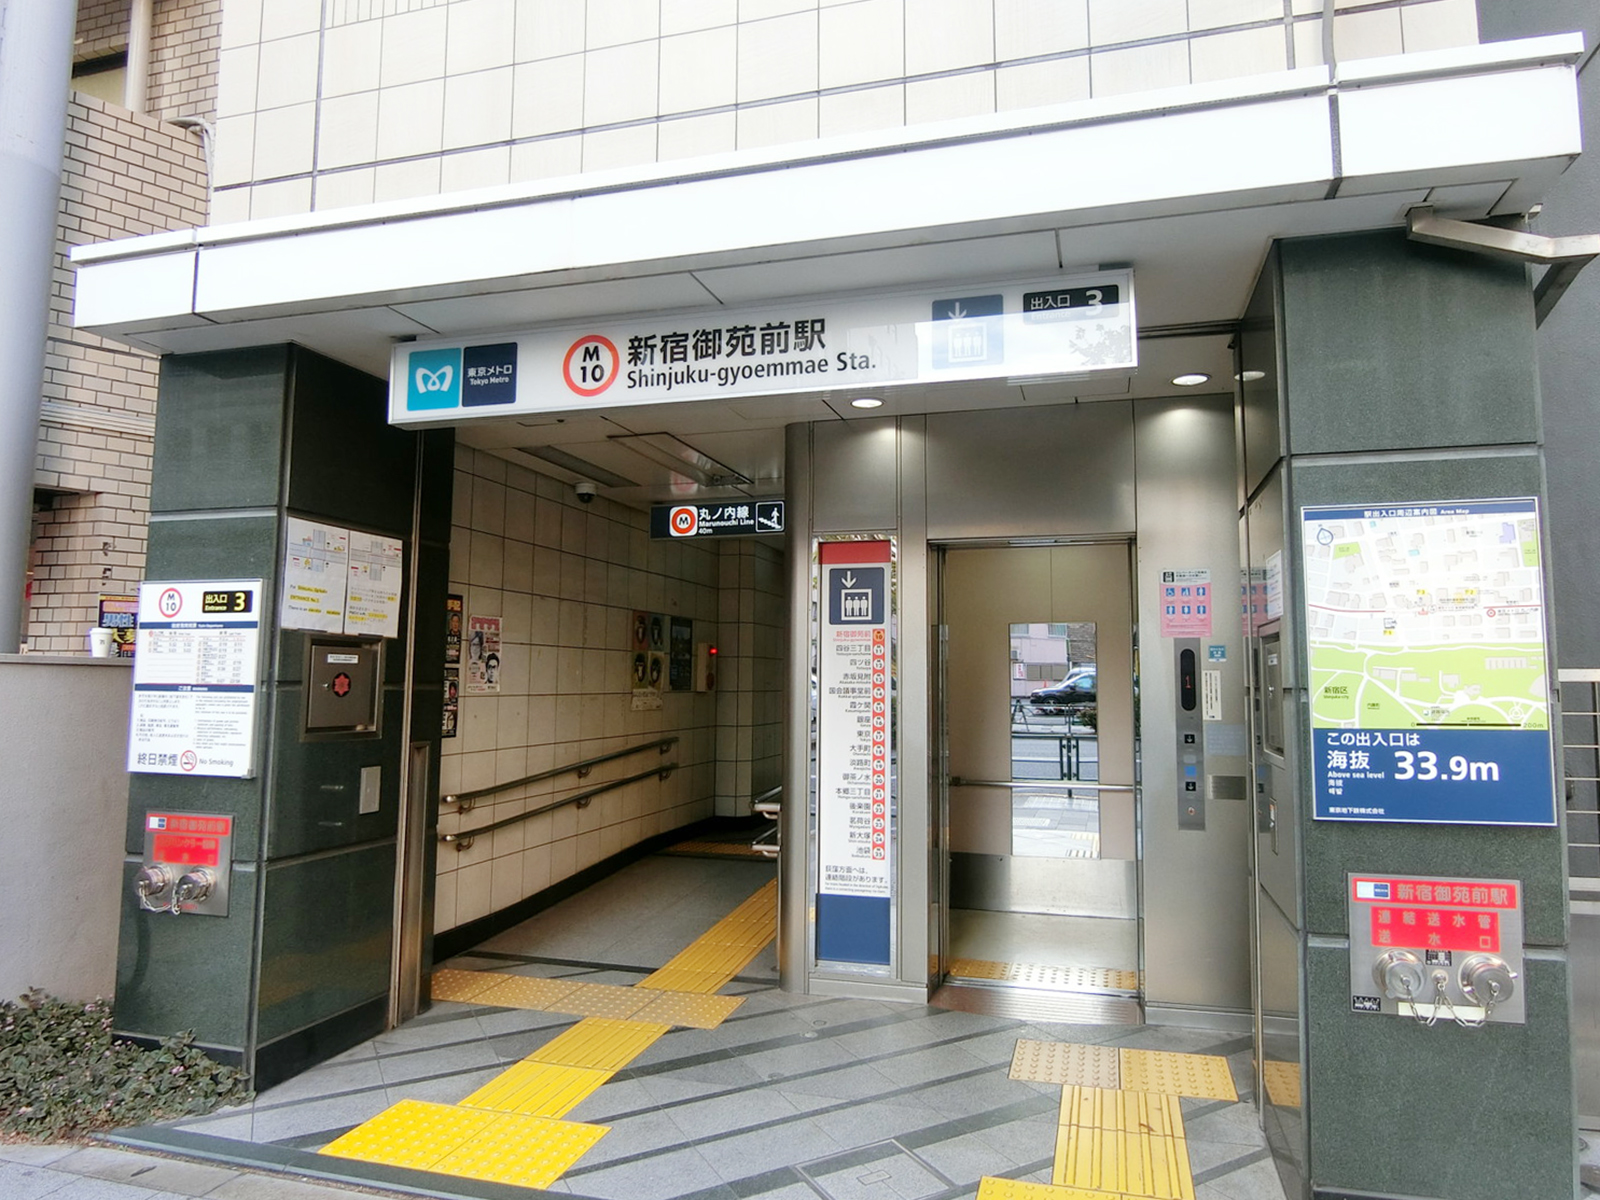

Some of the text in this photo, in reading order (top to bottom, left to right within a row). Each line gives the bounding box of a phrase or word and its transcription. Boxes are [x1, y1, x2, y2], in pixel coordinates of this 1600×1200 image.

[1030, 294, 1071, 310] 出入口
[1085, 289, 1104, 316] 3
[627, 318, 826, 367] 新宿御苑前駅
[582, 345, 600, 362] M
[467, 364, 513, 378] 東京メトロ
[580, 364, 604, 383] 10
[627, 352, 876, 391] Shinjuku-gyoemmae Sta.
[469, 376, 509, 386] Tokyo Metro
[699, 505, 750, 520] 丸ノ内線
[1363, 508, 1438, 518] 駅出入口周辺案内図
[678, 516, 689, 526] M
[698, 518, 754, 528] Marunouchi Line
[205, 594, 228, 603] 出入口
[234, 591, 245, 611] 3
[166, 602, 177, 611] 10
[1323, 685, 1348, 695] 新宿区
[1522, 721, 1544, 729] 200m
[1326, 732, 1421, 747] この出入口は
[199, 757, 208, 765] No
[208, 758, 234, 768] Smoking
[1326, 749, 1499, 781] 海抜 33.9m
[1327, 770, 1351, 778] Above
[1366, 771, 1385, 779] level
[1397, 883, 1508, 905] 新宿御苑前駅
[1377, 909, 1491, 929] 連結送水管
[1378, 930, 1492, 949] 送水口
